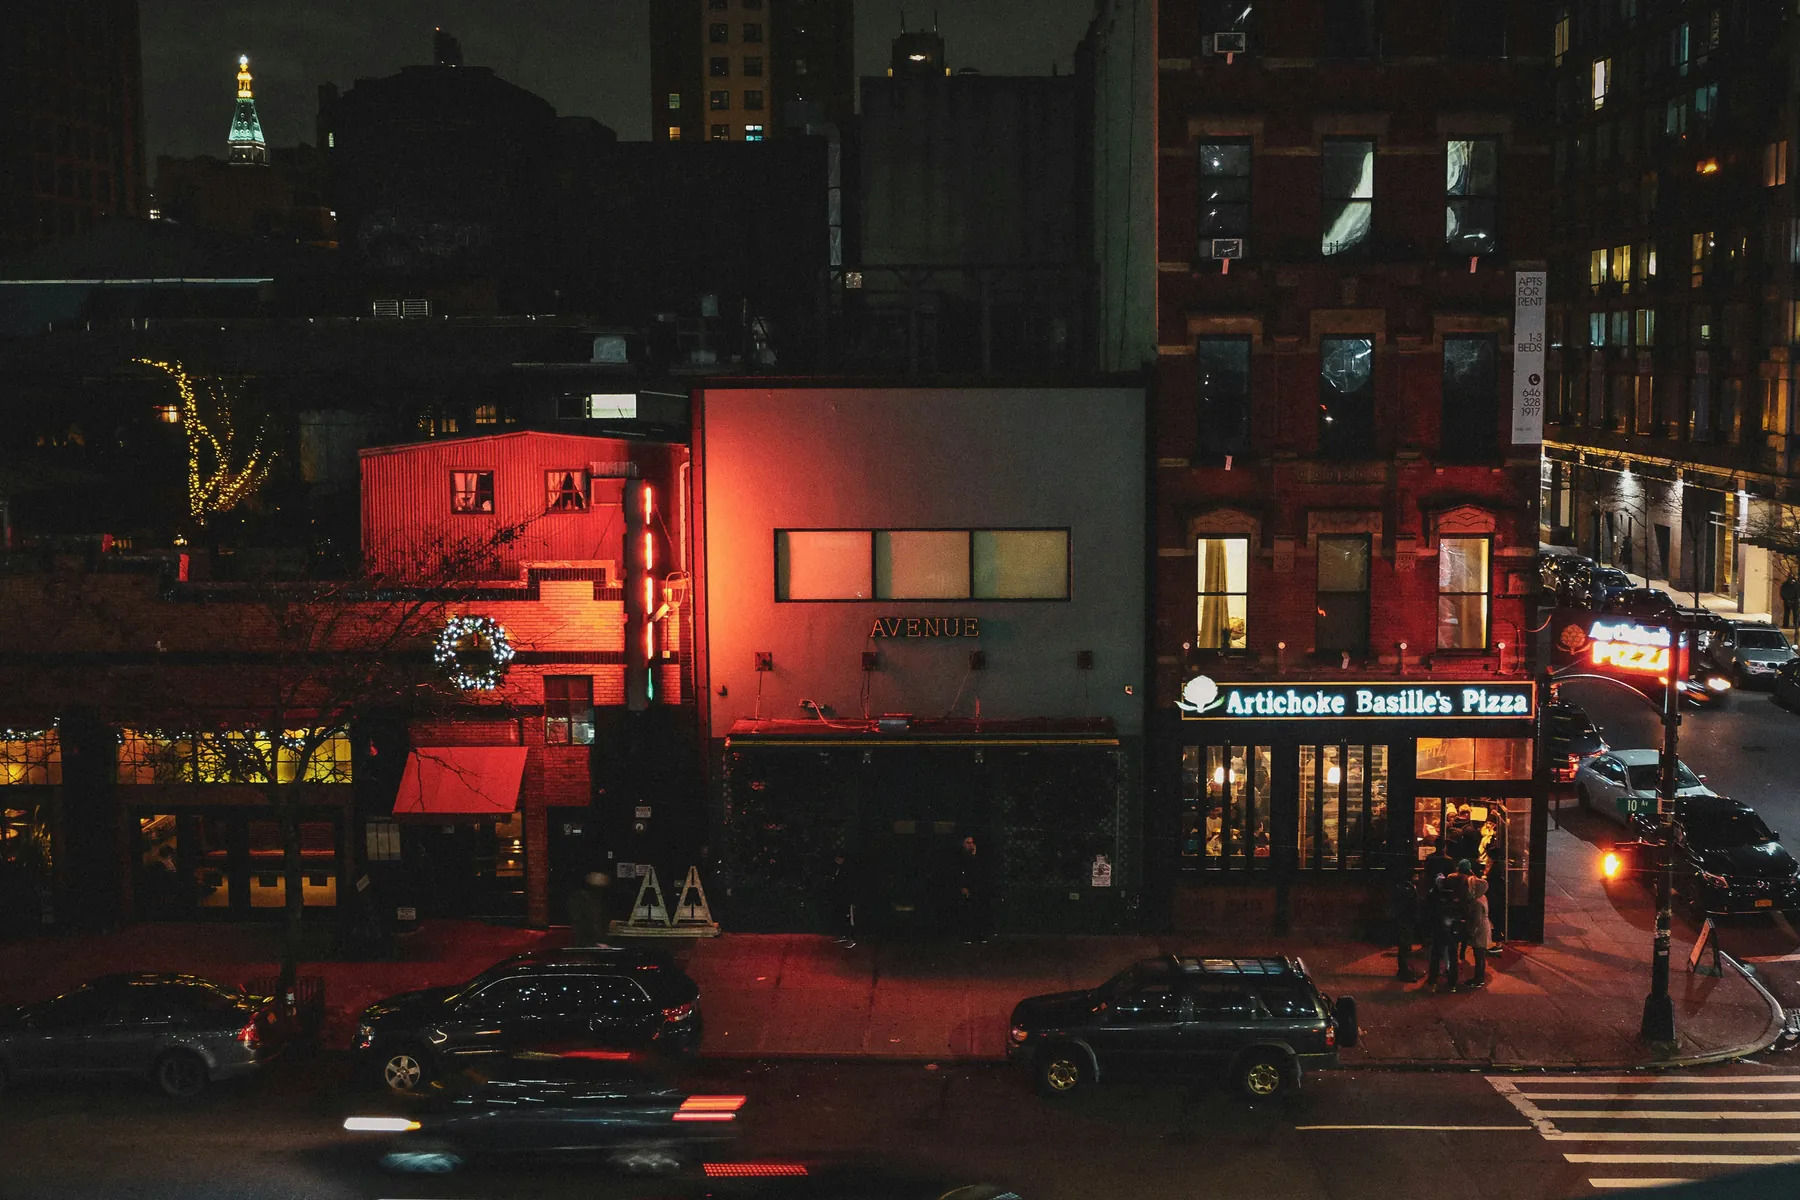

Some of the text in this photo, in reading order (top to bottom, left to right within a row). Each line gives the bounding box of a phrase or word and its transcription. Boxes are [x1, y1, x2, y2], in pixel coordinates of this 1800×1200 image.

[1518, 277, 1543, 287] APTS
[1518, 287, 1539, 297] FOR
[1517, 297, 1543, 307] RENT
[1529, 333, 1542, 342] 1-3
[1518, 343, 1542, 353] BEDS
[1522, 389, 1541, 398] 646
[1523, 398, 1541, 407] 328
[1521, 408, 1540, 417] 1917
[869, 618, 979, 638] AVENUE
[1226, 689, 1528, 714] Artichoke Basille's Pizza
[1627, 799, 1638, 812] 10
